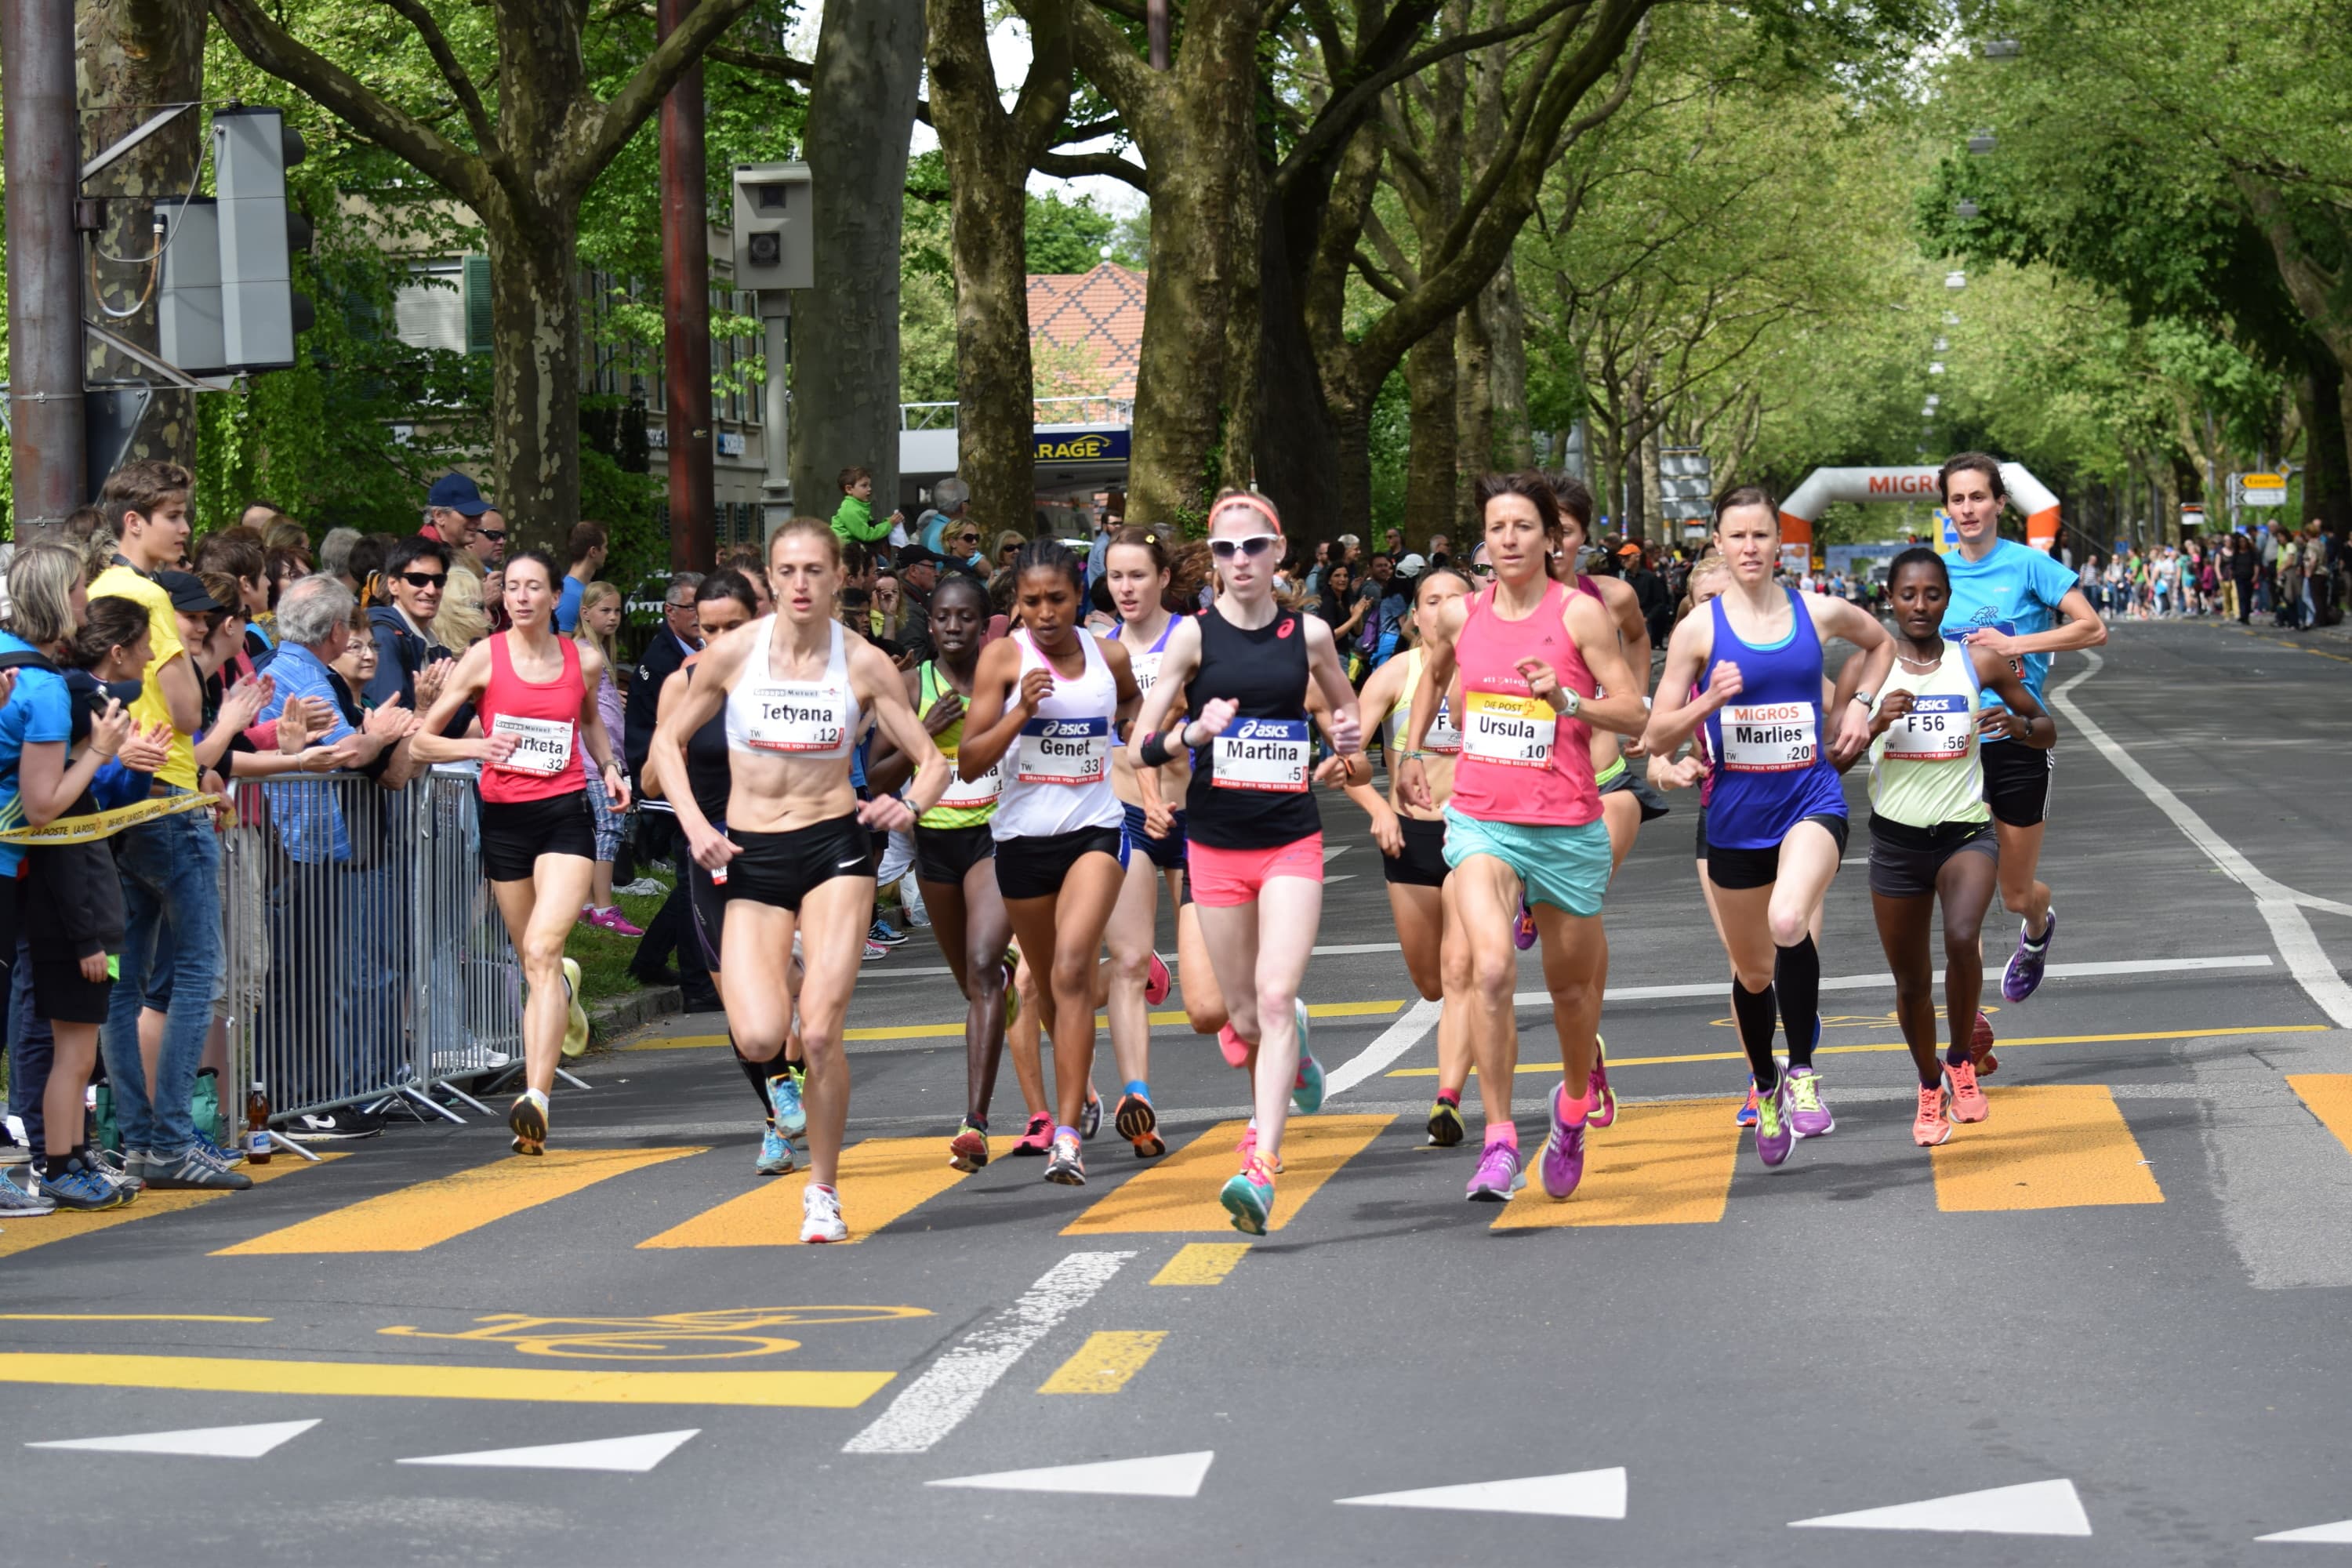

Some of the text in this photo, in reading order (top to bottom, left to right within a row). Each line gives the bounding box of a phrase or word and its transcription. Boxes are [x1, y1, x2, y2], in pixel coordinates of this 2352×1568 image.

[1034, 442, 1101, 459] RAGE
[1483, 700, 1523, 712] DIE POST
[1916, 699, 1950, 711] asics
[762, 703, 833, 724] Tetyana
[1734, 706, 1799, 720] MIGROS
[1058, 723, 1091, 735] asics
[1479, 716, 1535, 739] Ursula
[1907, 715, 1944, 733] F 56
[750, 729, 762, 739] TW
[1255, 725, 1289, 738] asics
[1736, 726, 1802, 744] Marlies
[1040, 739, 1091, 757] Genet
[1227, 740, 1298, 760] Martina
[1021, 763, 1033, 771] TW
[45, 826, 69, 836] POSTE
